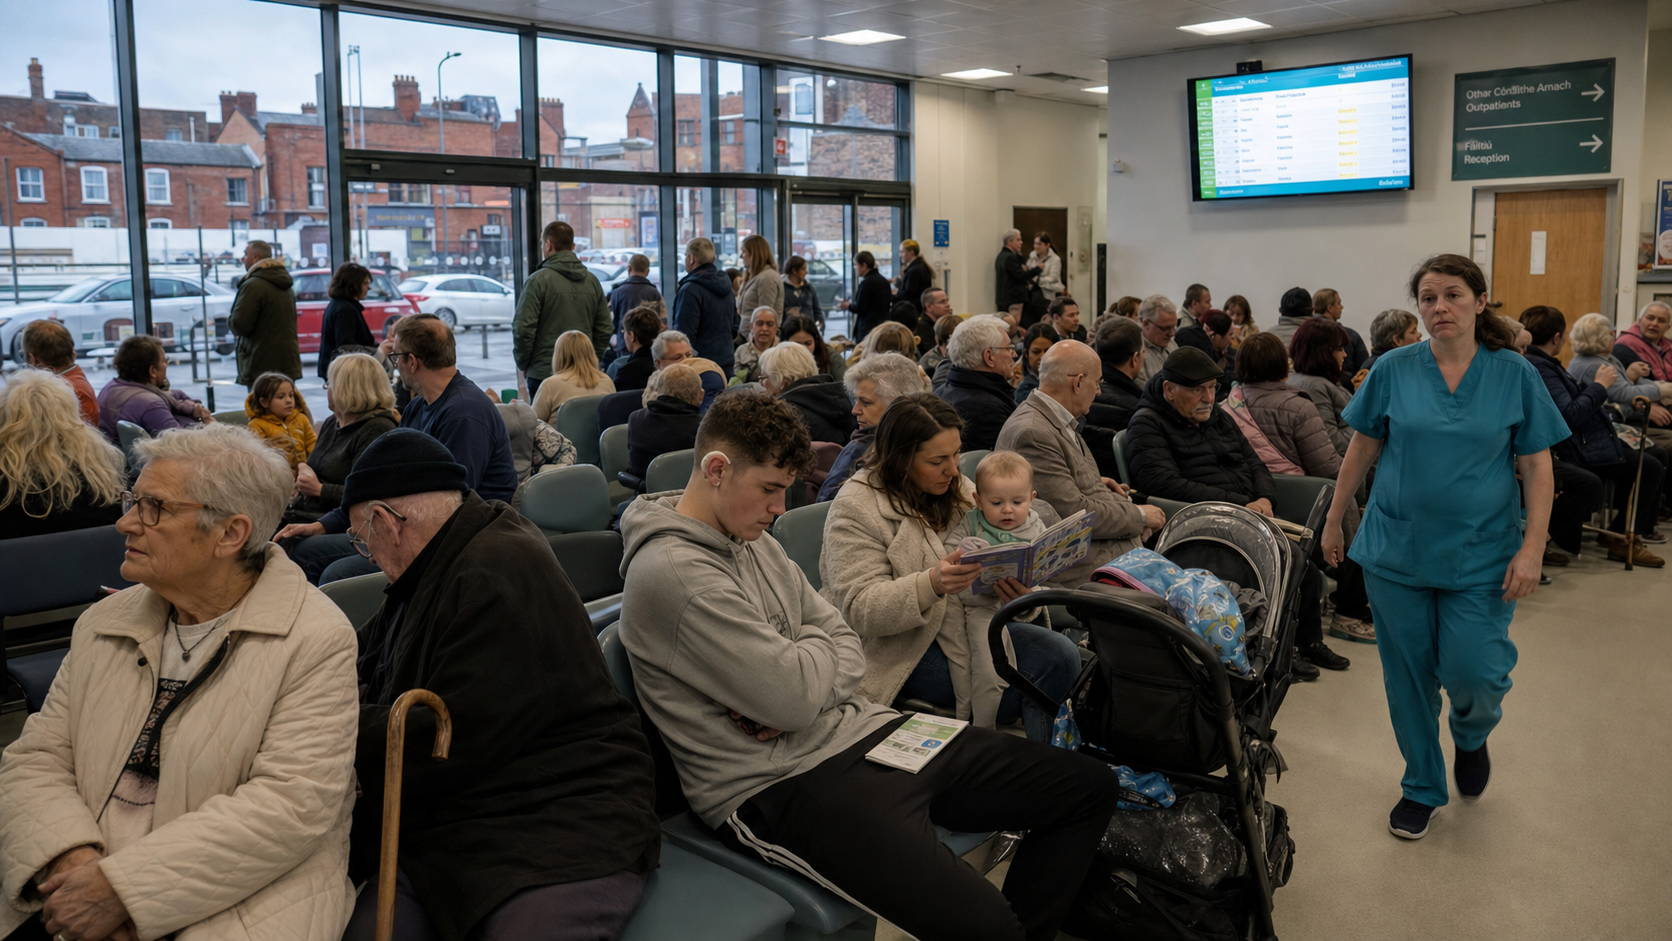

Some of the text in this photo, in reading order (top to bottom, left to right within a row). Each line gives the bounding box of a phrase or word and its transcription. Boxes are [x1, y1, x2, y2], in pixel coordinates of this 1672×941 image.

[1466, 90, 1491, 99] Othar
[1537, 80, 1571, 92] Amach
[1466, 100, 1521, 113] Outpatients
[1464, 153, 1510, 165] Reception
